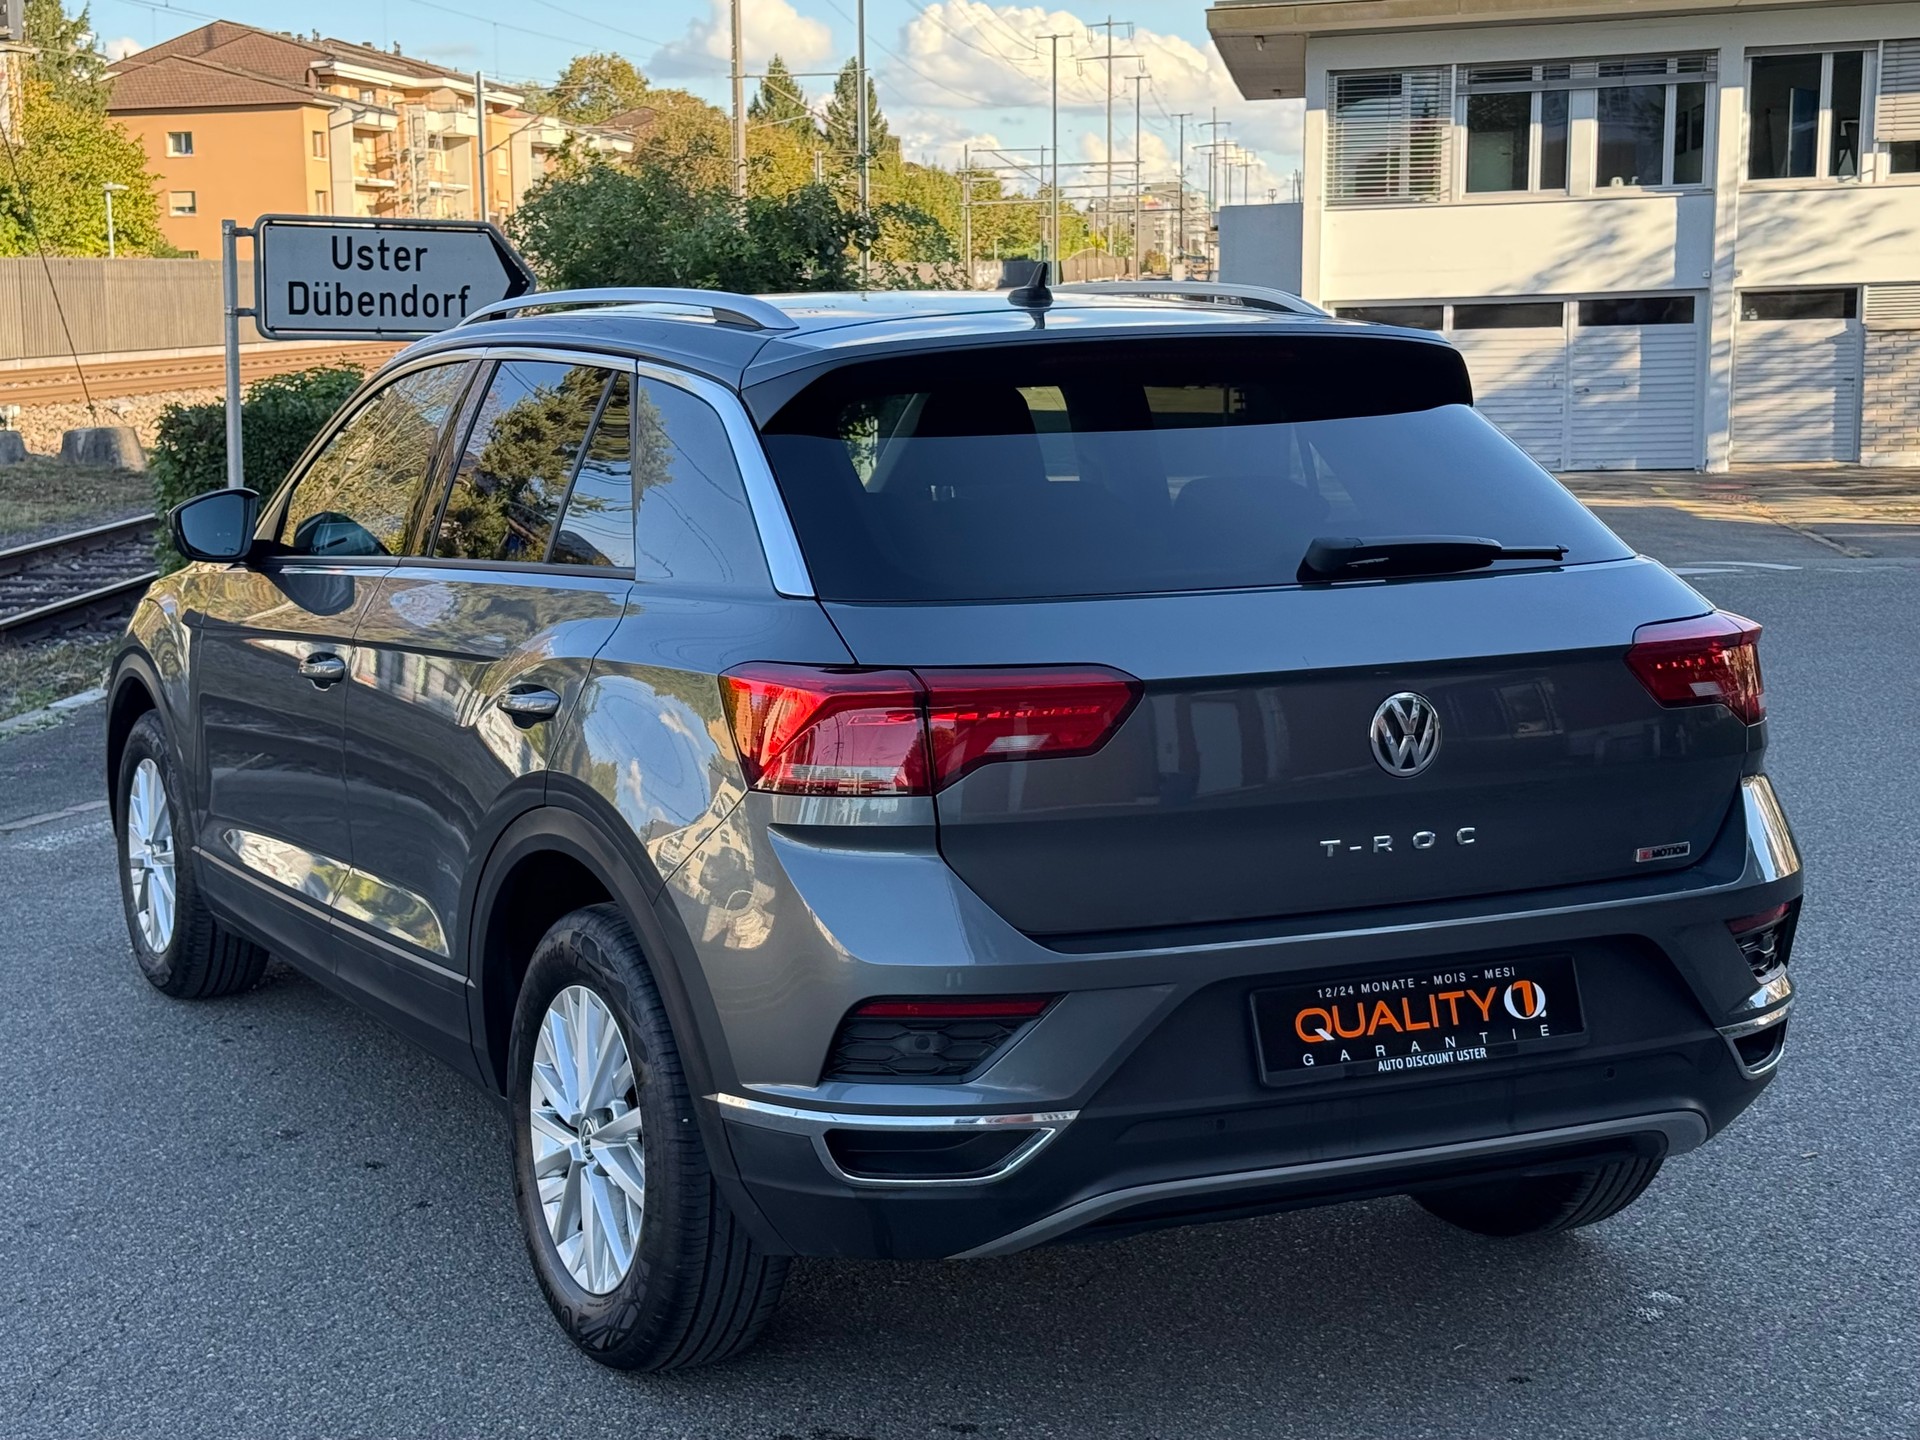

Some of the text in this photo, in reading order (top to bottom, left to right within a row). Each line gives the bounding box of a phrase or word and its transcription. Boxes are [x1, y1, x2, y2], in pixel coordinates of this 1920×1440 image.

[331, 235, 428, 272] Uster
[287, 281, 471, 318] Dübendorf
[1319, 826, 1476, 857] T-ROC
[1317, 986, 1354, 998] 12/24
[1361, 978, 1415, 994] MONATE
[1433, 971, 1467, 986] MOIS
[1484, 966, 1516, 980] MESI
[1295, 986, 1497, 1043] QUALITY
[1302, 1024, 1550, 1066] GARANTIE
[1378, 1047, 1487, 1072] AUTO DISCOUNT USTER
